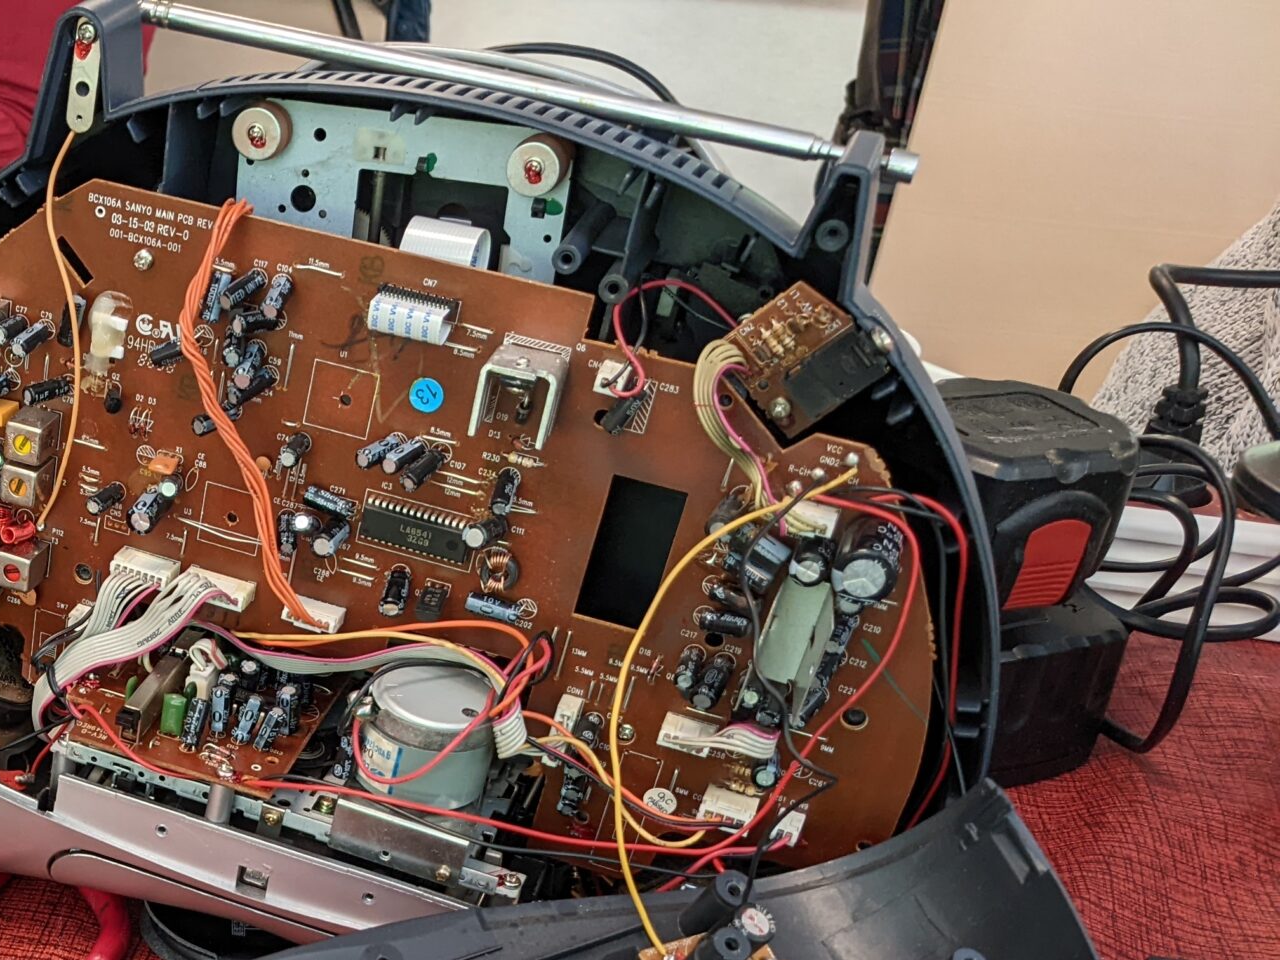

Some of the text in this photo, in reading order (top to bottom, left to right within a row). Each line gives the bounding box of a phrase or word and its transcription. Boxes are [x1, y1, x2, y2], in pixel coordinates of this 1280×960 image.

[88, 192, 213, 231] BCX106A SANYO MAIN PCB REV
[111, 212, 155, 233] 03-15-03
[109, 228, 181, 253] 001-BCX106A-001
[253, 258, 268, 268] C117
[276, 263, 293, 273] C104
[422, 277, 438, 287] CN7
[465, 328, 488, 340] 7.5mm
[659, 383, 680, 394] C283
[826, 443, 843, 455] VCC
[482, 451, 500, 463] R230
[819, 455, 840, 467] GND2
[449, 460, 467, 471] C107
[329, 485, 346, 495] C271
[680, 628, 698, 639] C217
[862, 623, 882, 634] C210
[571, 647, 587, 657] 13MM
[848, 657, 868, 669] C212
[566, 686, 584, 696] CON1
